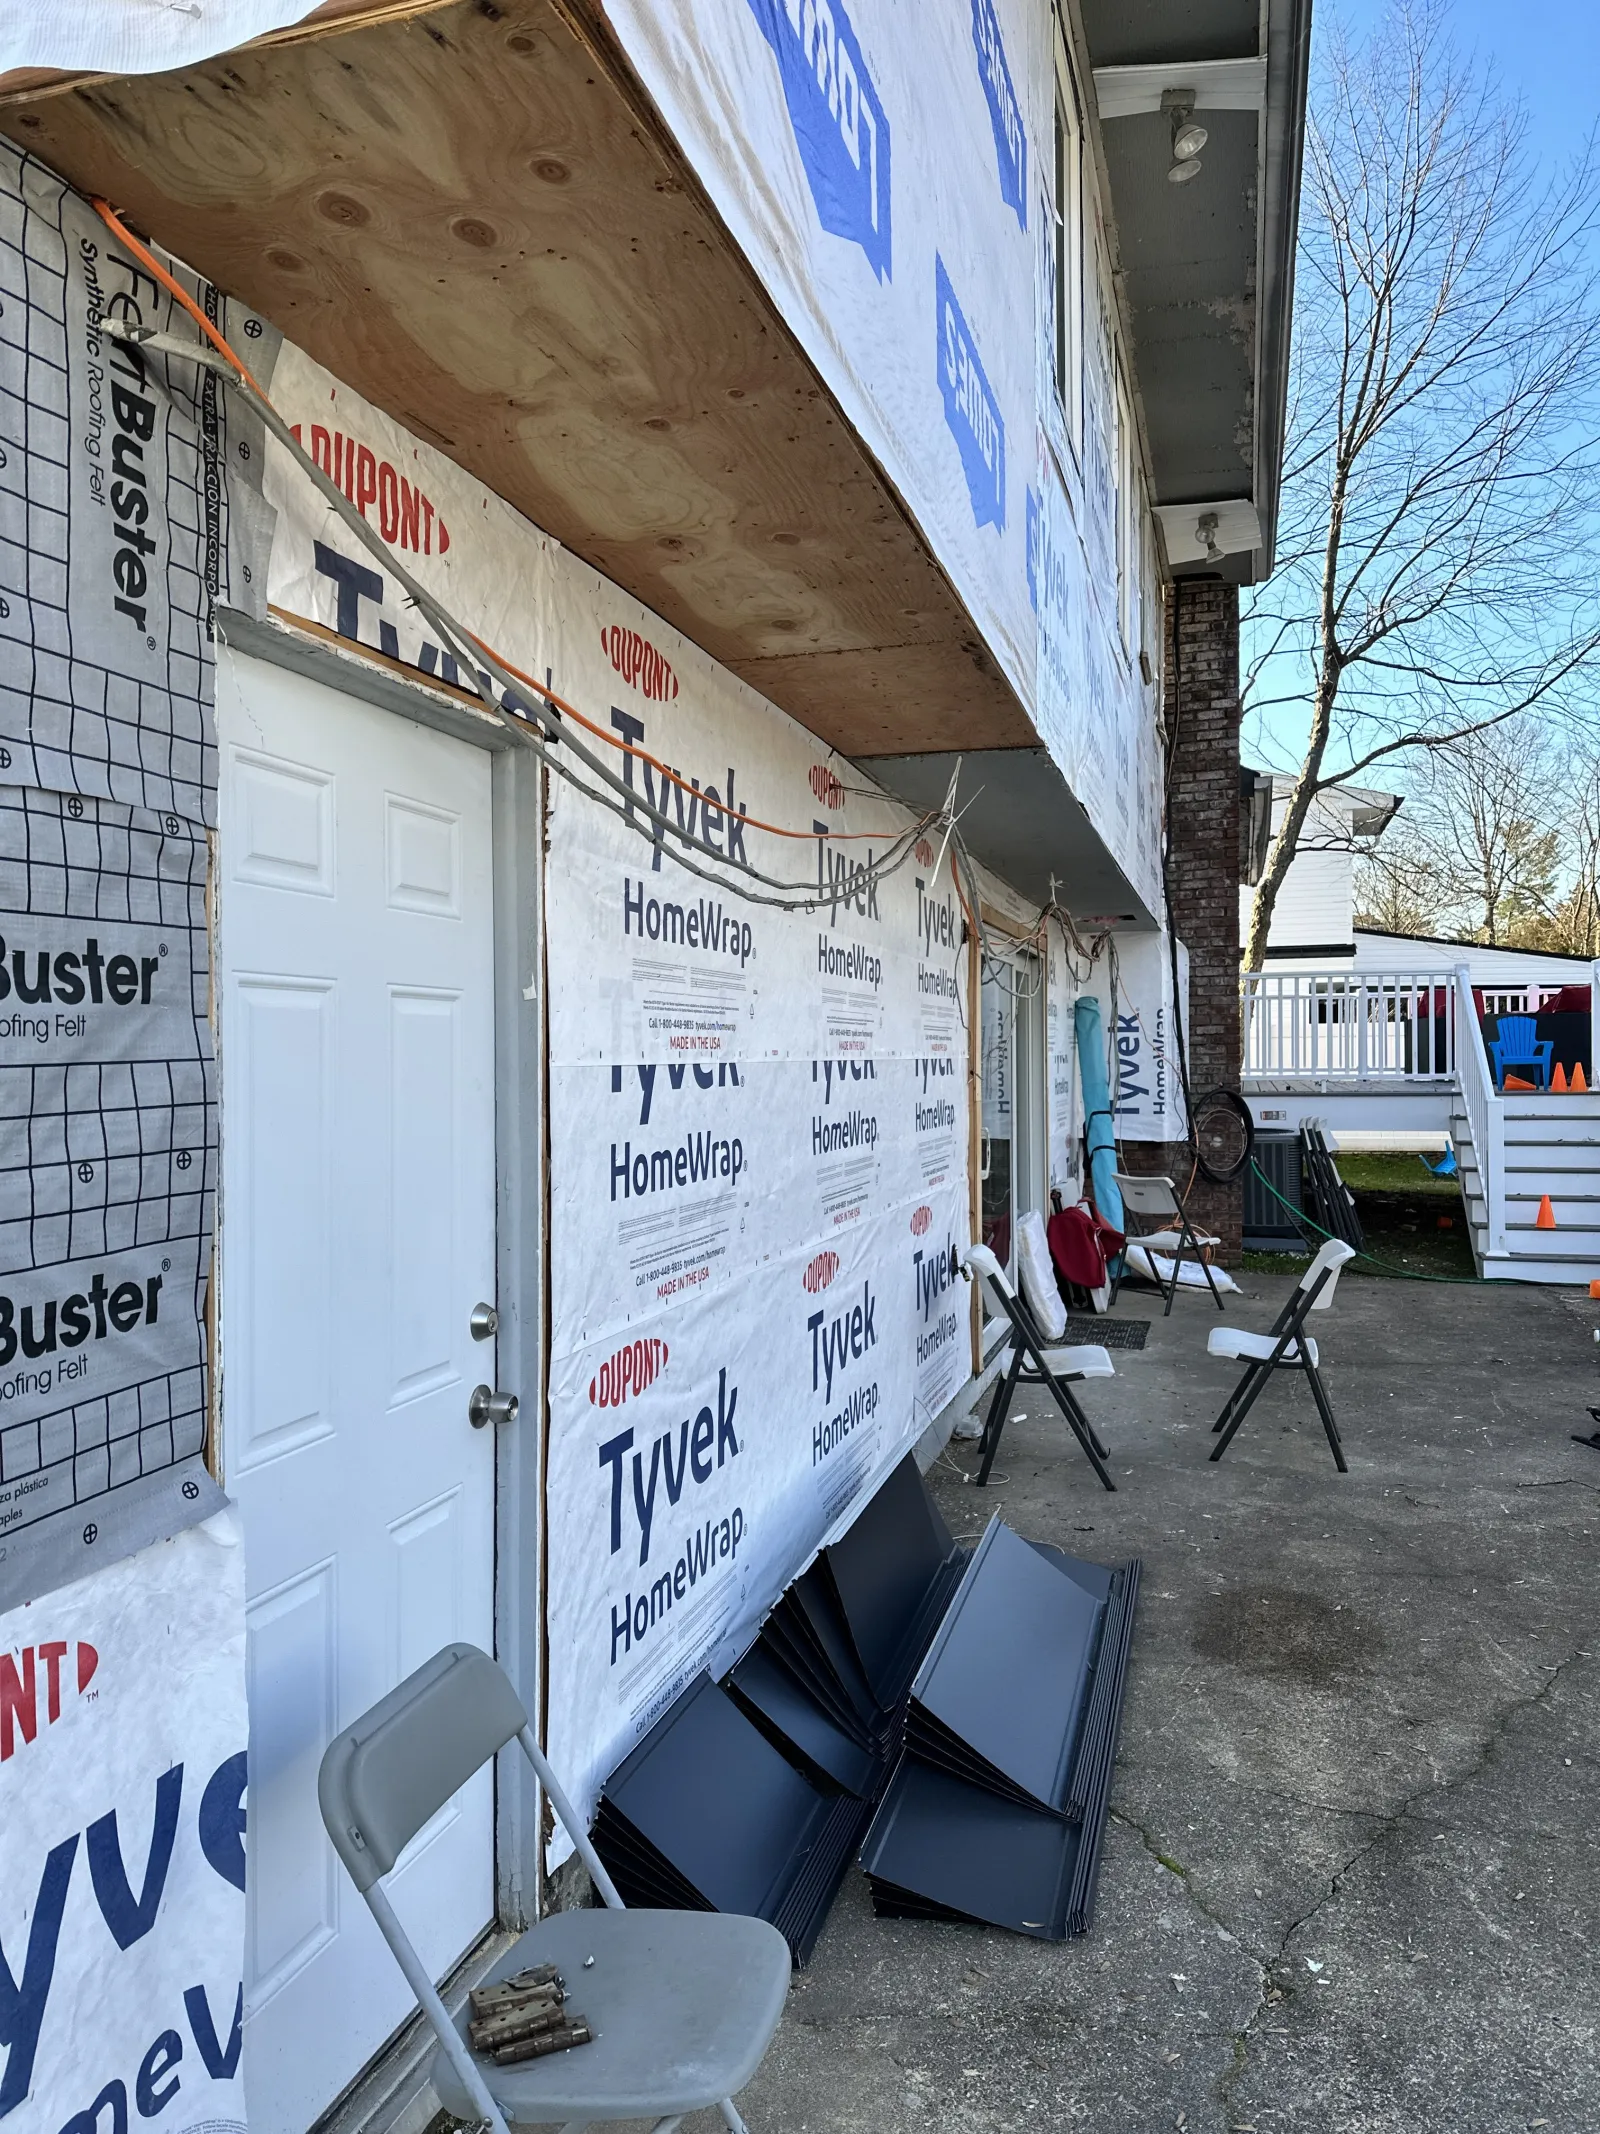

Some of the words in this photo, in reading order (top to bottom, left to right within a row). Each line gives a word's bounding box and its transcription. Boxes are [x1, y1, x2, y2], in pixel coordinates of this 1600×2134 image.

[80, 237, 104, 357] Synthetic
[85, 360, 106, 459] Roofing
[89, 461, 106, 507] Felt
[311, 424, 434, 555] DUPONT
[610, 625, 672, 702] DUPONT
[611, 706, 748, 872] Tyvek
[813, 819, 880, 928] Tyvek
[624, 877, 752, 968] HomeWrap
[916, 877, 955, 957] Tyvek
[818, 933, 881, 992] HomeWrap
[918, 962, 957, 1005] HomeWrap
[55, 1013, 86, 1038] Felt
[670, 1036, 689, 1050] MADE
[690, 1036, 696, 1050] IN
[697, 1036, 708, 1050] THE
[710, 1036, 721, 1050] USA
[813, 1110, 877, 1155] HomeWrap
[915, 1099, 954, 1132] HomeWrap
[611, 1131, 743, 1202] HomeWrap
[636, 1274, 646, 1286] Call
[646, 1261, 682, 1282] 1-800-448-9835
[656, 1280, 676, 1300] MADE
[678, 1276, 684, 1289] IN
[686, 1272, 698, 1288] THE
[698, 1266, 710, 1282] USA
[807, 1251, 837, 1293] DUPONT
[913, 1232, 956, 1323] Tyvek
[599, 1338, 660, 1408] DUPONT
[807, 1280, 876, 1406] Tyvek
[916, 1312, 957, 1367] HomeWrap
[0, 1368, 51, 1400] ofing
[58, 1354, 88, 1384] Felt
[813, 1382, 878, 1467] HomeWrap
[599, 1367, 739, 1567] Tyvek
[611, 1507, 743, 1666] HomeWrap
[636, 1716, 646, 1733] Call
